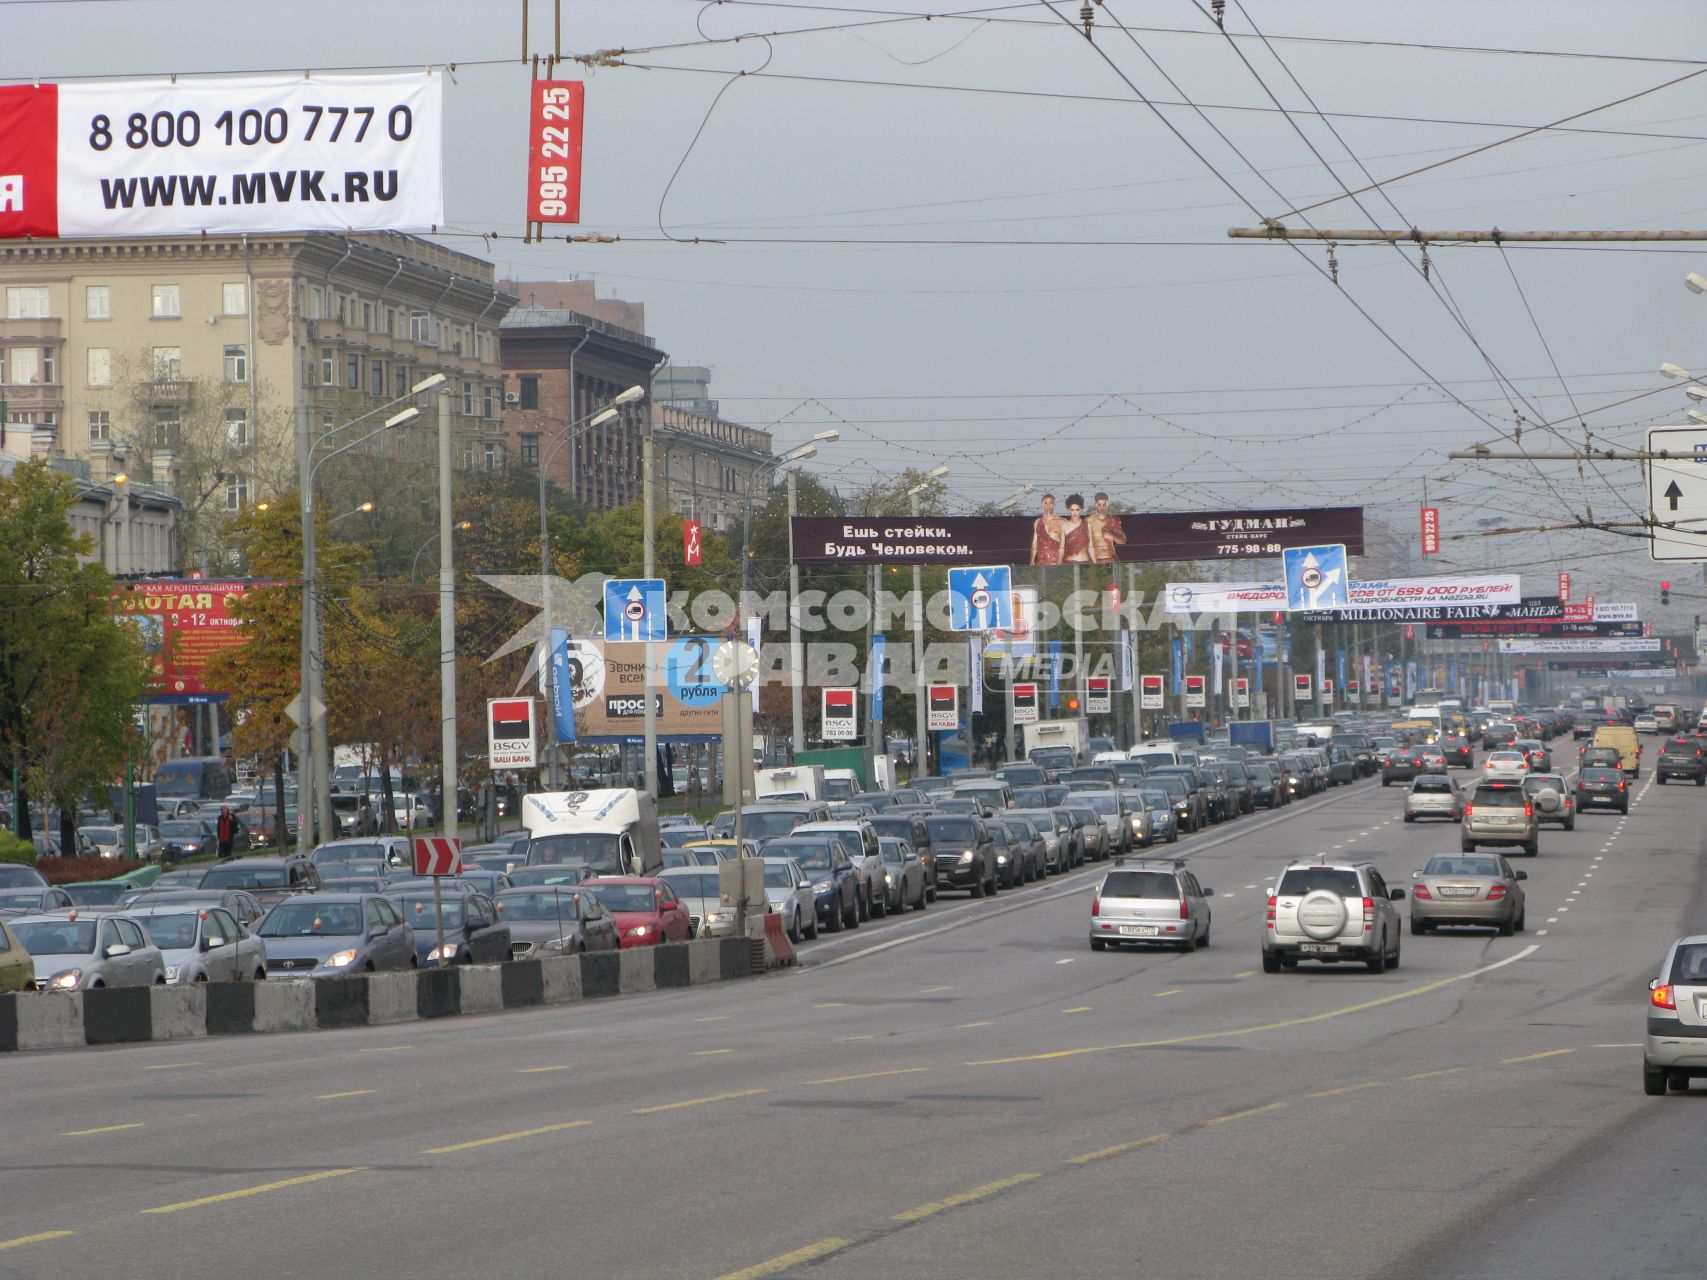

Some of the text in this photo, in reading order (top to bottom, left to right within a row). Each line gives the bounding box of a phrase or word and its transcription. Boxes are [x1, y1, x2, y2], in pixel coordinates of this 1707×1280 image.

[89, 104, 413, 151] 8 800 100 777 0
[540, 87, 570, 216] 995 22 25
[100, 170, 399, 210] WWW.MVK.RU
[843, 525, 952, 538] Ешь стейки.
[1425, 510, 1436, 551] 995 22 25
[825, 542, 973, 557] Будь Человеком.
[1227, 592, 1287, 600] ВНЕДОРО
[1377, 589, 1394, 597] ОТ
[1397, 587, 1425, 596] 699
[1427, 586, 1458, 595] 000
[1460, 583, 1514, 594] РУБЛЕЙ!
[190, 613, 206, 626] 12
[1340, 606, 1441, 620] MILLIONAIRE
[1447, 605, 1481, 617] FAIR
[683, 638, 711, 683] 2
[681, 684, 718, 701] рубля
[493, 741, 531, 751] BSGV
[493, 755, 532, 764] ВАШ БАНК
